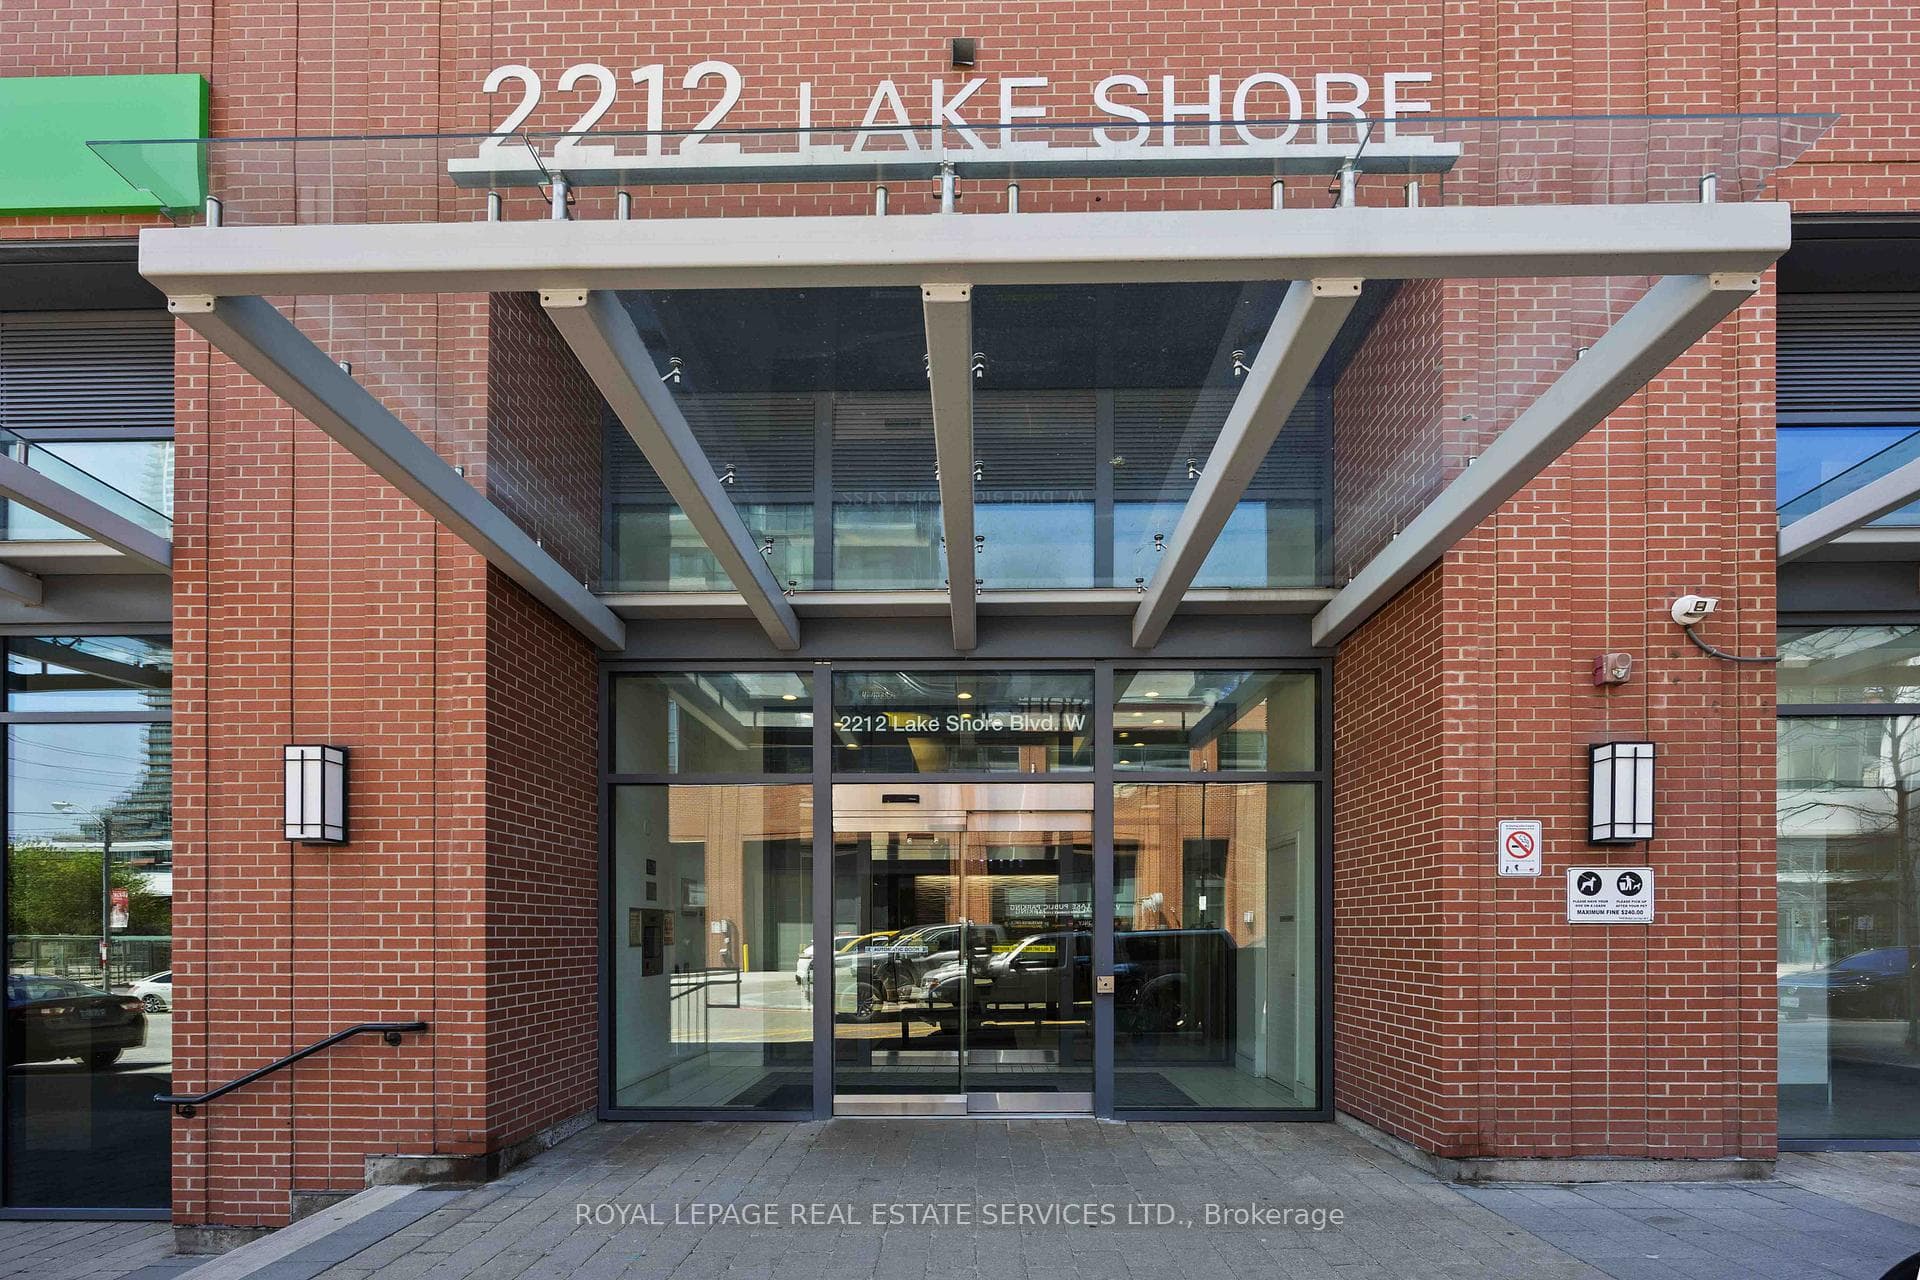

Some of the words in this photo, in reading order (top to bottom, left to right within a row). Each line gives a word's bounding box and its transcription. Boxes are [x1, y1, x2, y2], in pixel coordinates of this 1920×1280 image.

[479, 61, 741, 156] 2212
[799, 77, 1048, 152] LAKE
[1092, 72, 1434, 146] SHORE
[840, 715, 887, 732] 2212
[893, 715, 940, 732] Lake
[946, 715, 1004, 732] Shore
[1010, 715, 1059, 732] Blvd.
[1065, 715, 1086, 732] W
